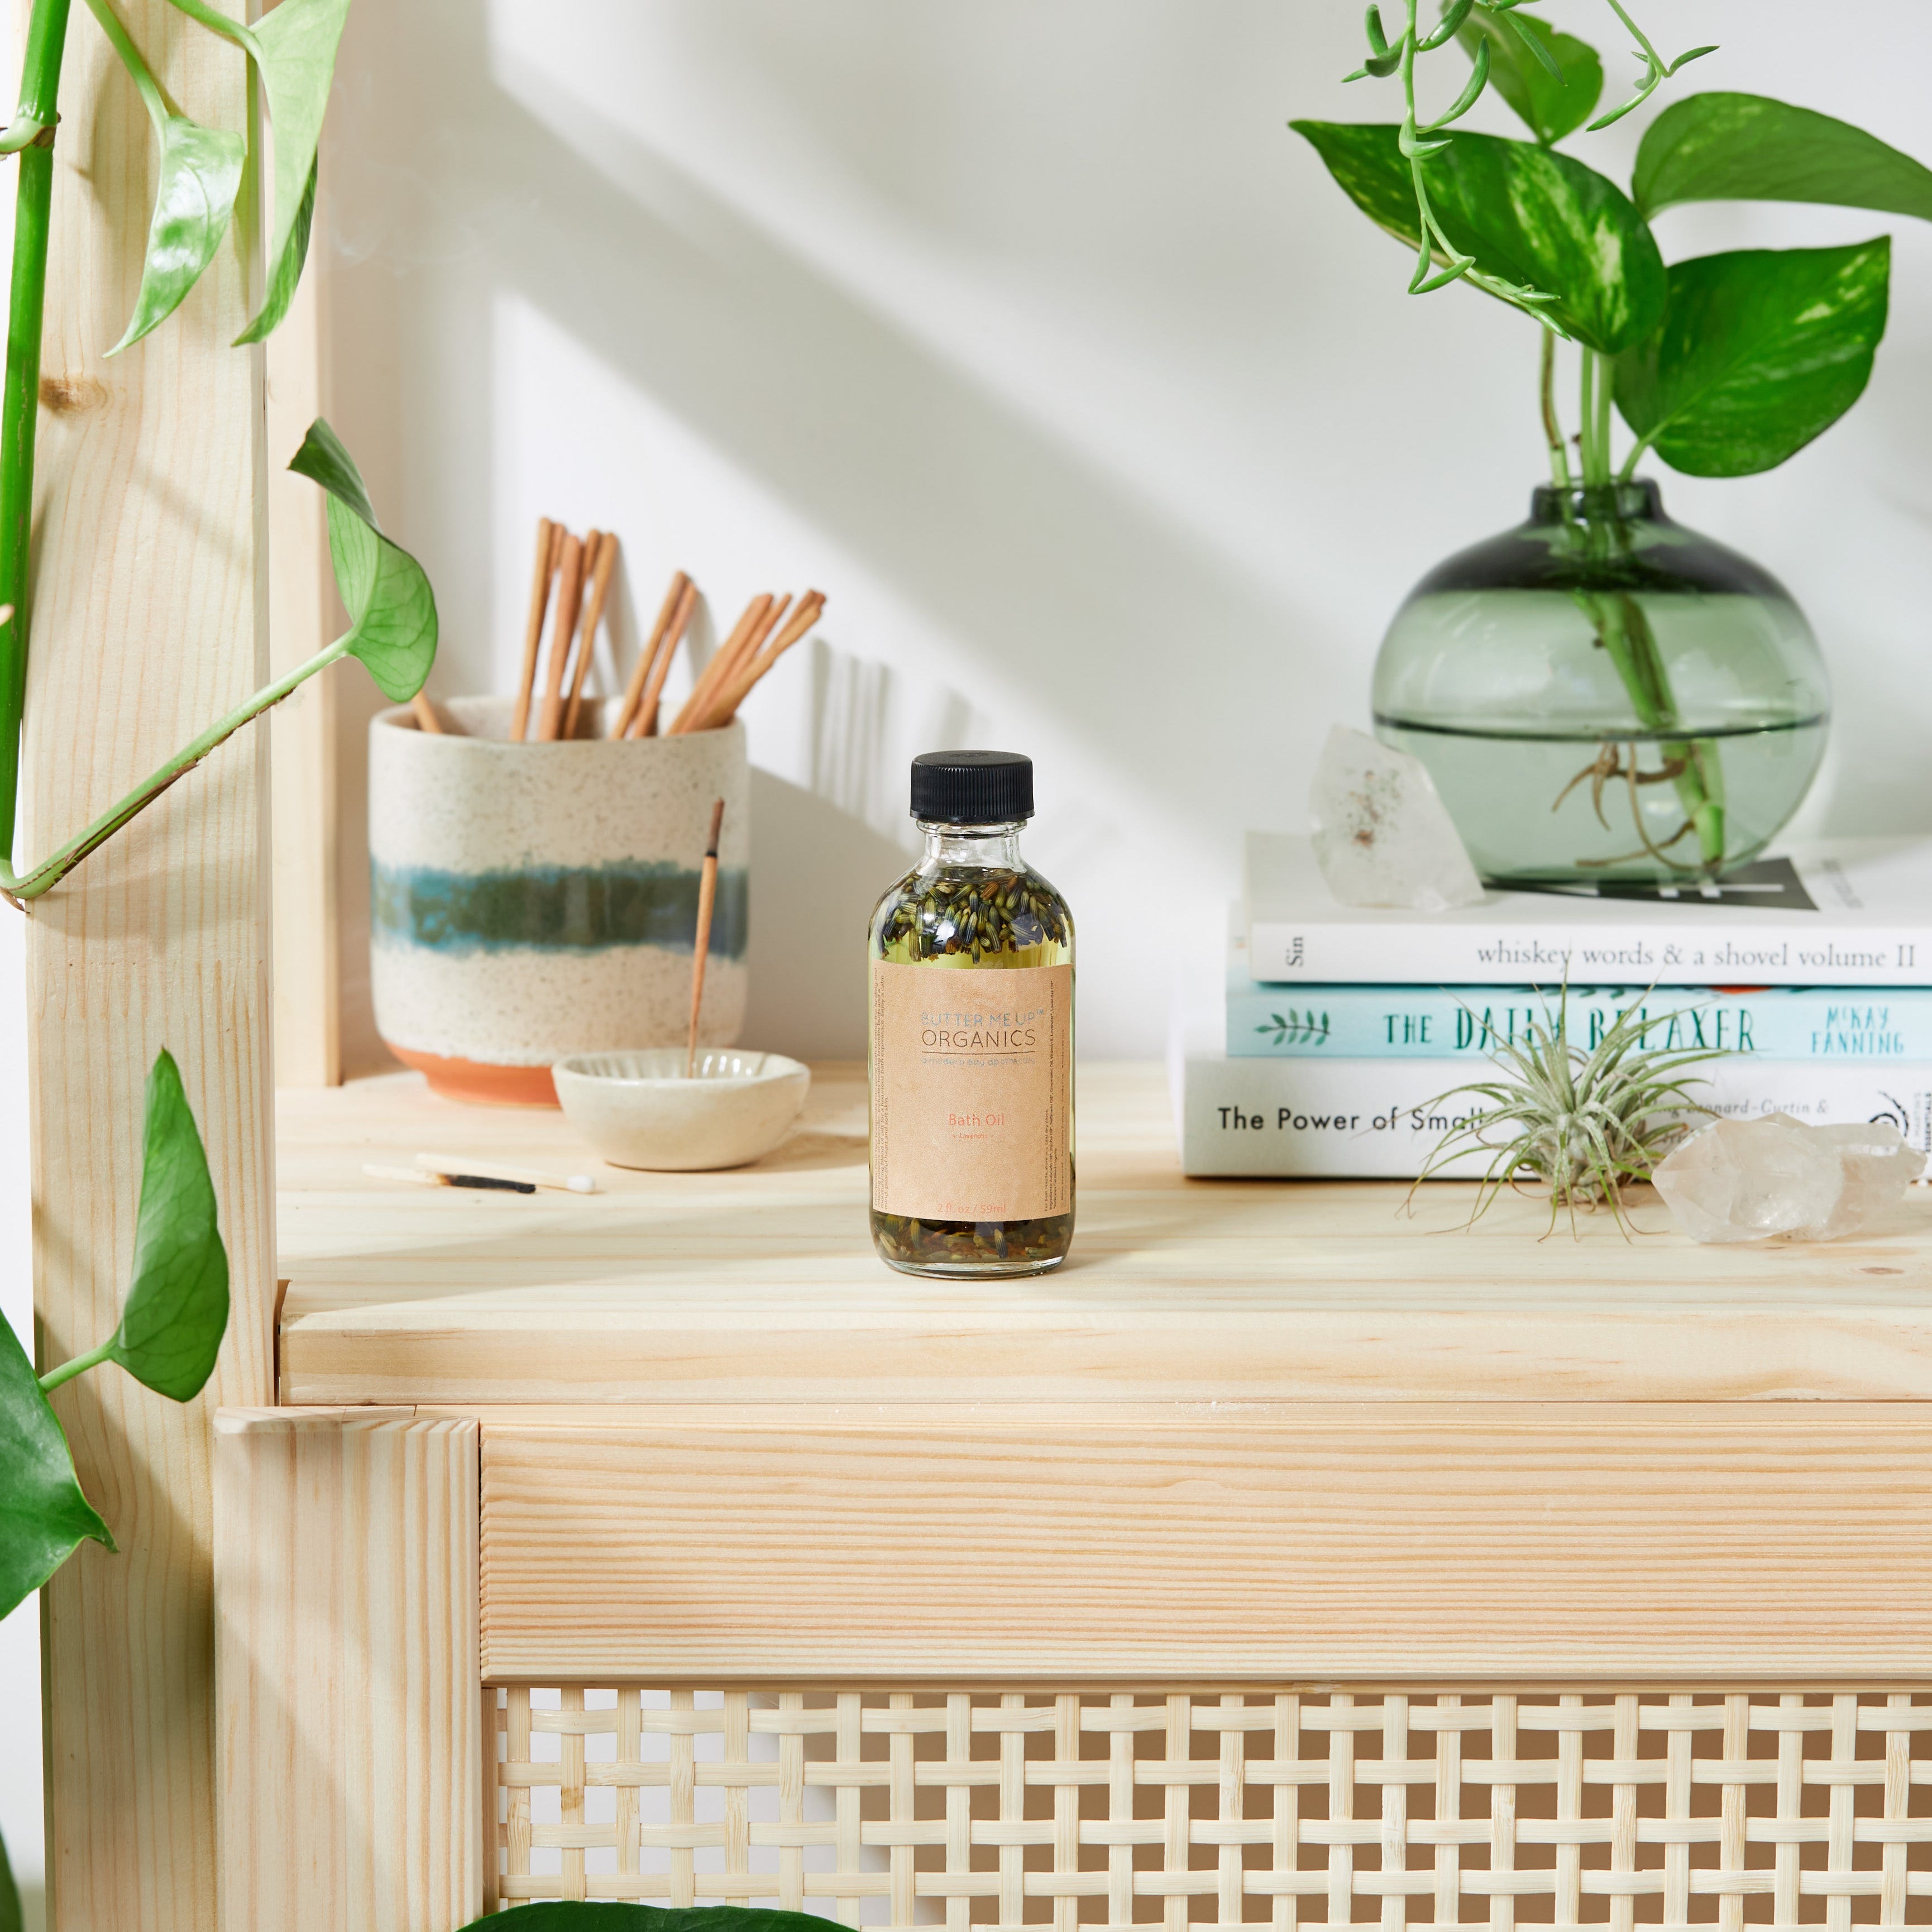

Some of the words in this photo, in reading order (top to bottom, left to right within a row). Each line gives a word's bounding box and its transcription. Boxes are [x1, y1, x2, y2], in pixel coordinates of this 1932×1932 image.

[1287, 936, 1305, 967] Sin
[1477, 940, 1571, 973] whiskey
[1583, 941, 1654, 966] words
[1663, 944, 1683, 966] &
[1694, 953, 1706, 966] a
[1715, 943, 1788, 967] shovel
[1799, 943, 1886, 968] volume
[1897, 944, 1916, 967] II
[922, 1012, 983, 1027] BUTTER
[989, 1013, 1011, 1026] ME
[1384, 1015, 1432, 1044] THE
[1589, 1007, 1755, 1051] RLAXER
[922, 1029, 1036, 1048] ORGANICS
[1812, 1032, 1905, 1054] FANNING
[1816, 1098, 1829, 1115] &
[949, 1113, 981, 1127] Bath
[985, 1113, 1005, 1126] Oil
[1218, 1106, 1264, 1130] The
[1278, 1108, 1359, 1130] Power
[1373, 1106, 1398, 1130] of
[1412, 1107, 1483, 1130] Small
[938, 1203, 943, 1213] 2
[981, 1204, 1007, 1213] 59ml
